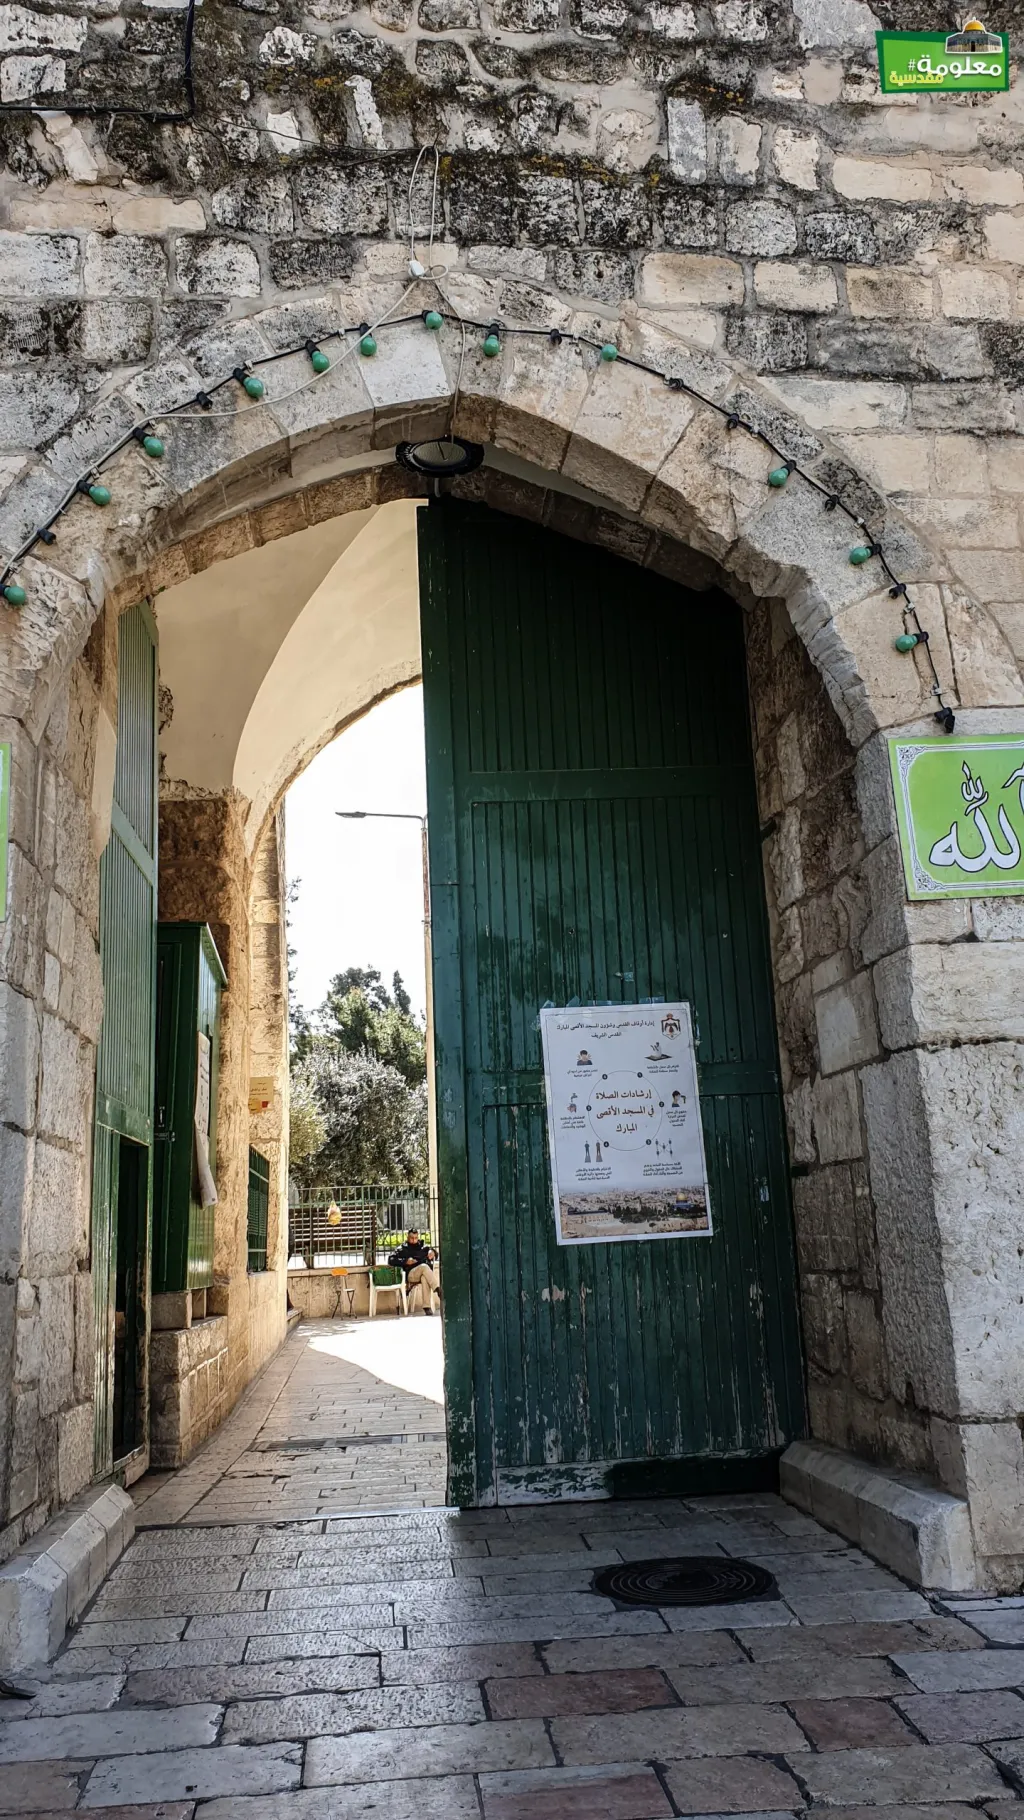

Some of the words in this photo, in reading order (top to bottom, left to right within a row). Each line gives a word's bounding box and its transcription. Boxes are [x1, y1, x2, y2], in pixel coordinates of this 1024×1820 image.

[595, 1090, 619, 1100] الصلاة
[621, 1089, 652, 1099] إرشادات
[596, 1105, 620, 1119] الأقصى
[622, 1105, 646, 1117] المسجد
[647, 1104, 655, 1118] في
[616, 1122, 638, 1134] المبارك
